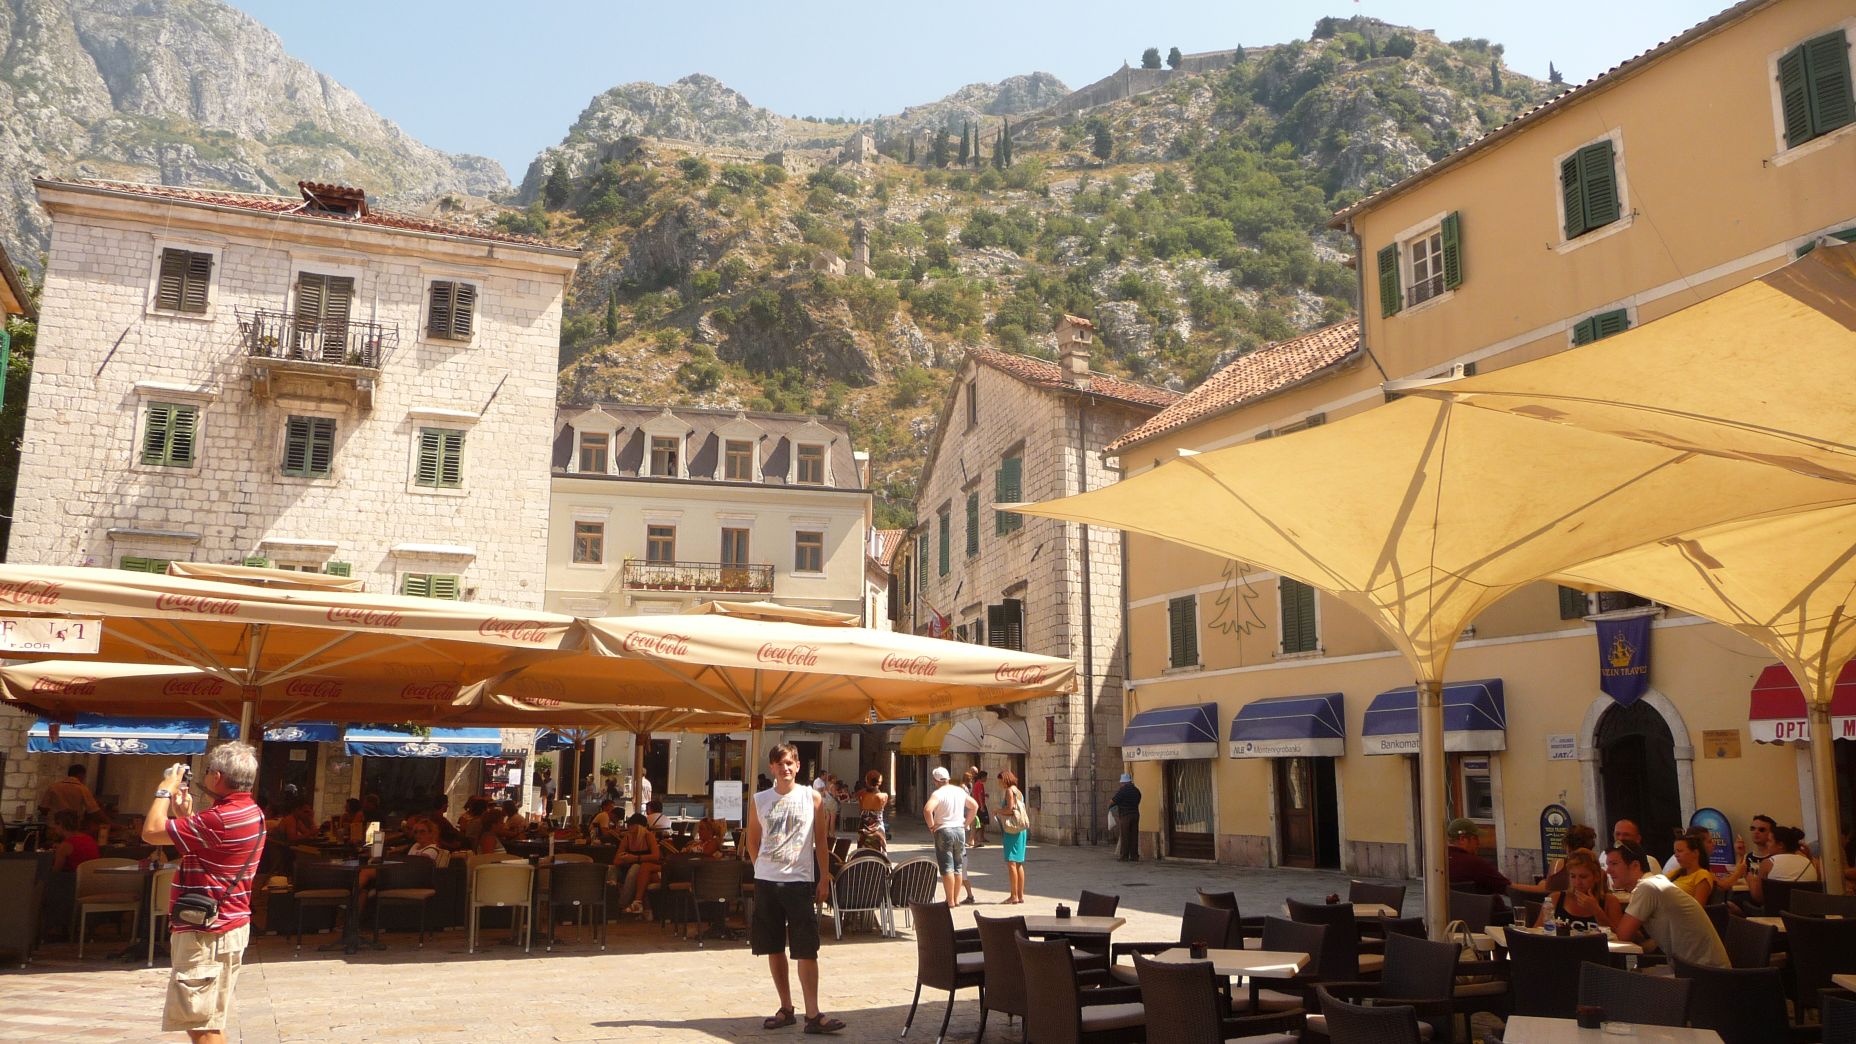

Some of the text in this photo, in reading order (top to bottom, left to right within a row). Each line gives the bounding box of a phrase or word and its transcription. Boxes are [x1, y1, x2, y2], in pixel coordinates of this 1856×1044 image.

[0, 579, 64, 604] a-Cola
[479, 617, 552, 643] Coca-Cola
[623, 631, 691, 655] Coca-Cola
[756, 642, 820, 666] Coca-Cola
[881, 652, 938, 677] Coca-Cola
[995, 662, 1048, 685] Coca-Cola
